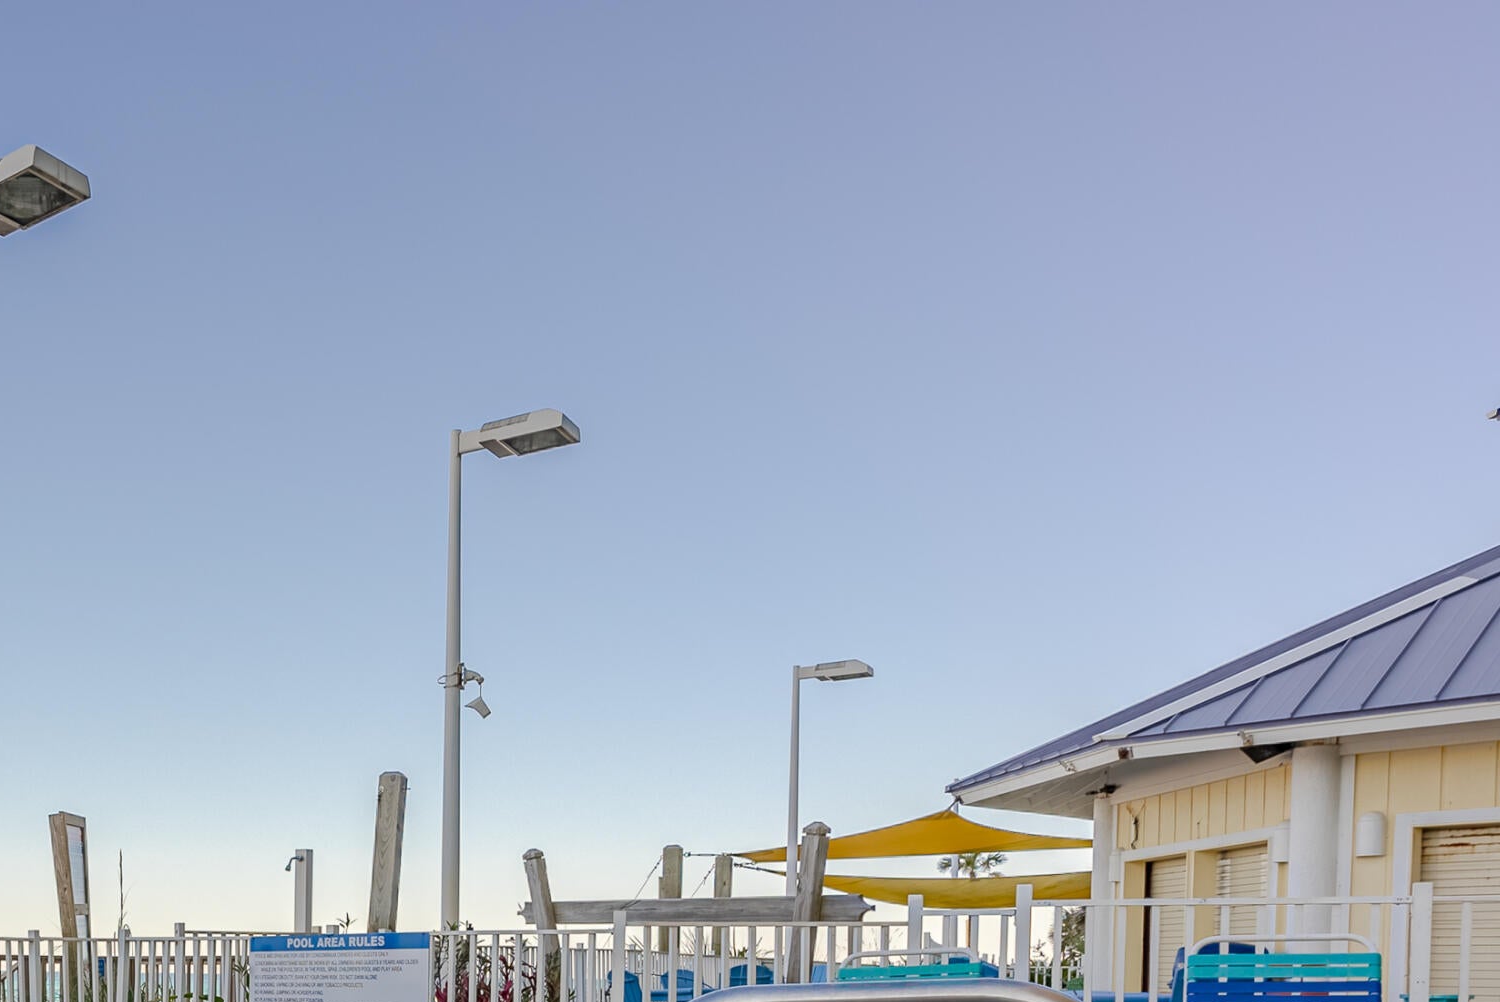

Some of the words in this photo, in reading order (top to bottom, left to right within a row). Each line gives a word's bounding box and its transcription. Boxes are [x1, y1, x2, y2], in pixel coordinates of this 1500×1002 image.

[286, 938, 315, 948] POOL
[317, 937, 346, 948] AREA
[348, 936, 386, 948] RULES
